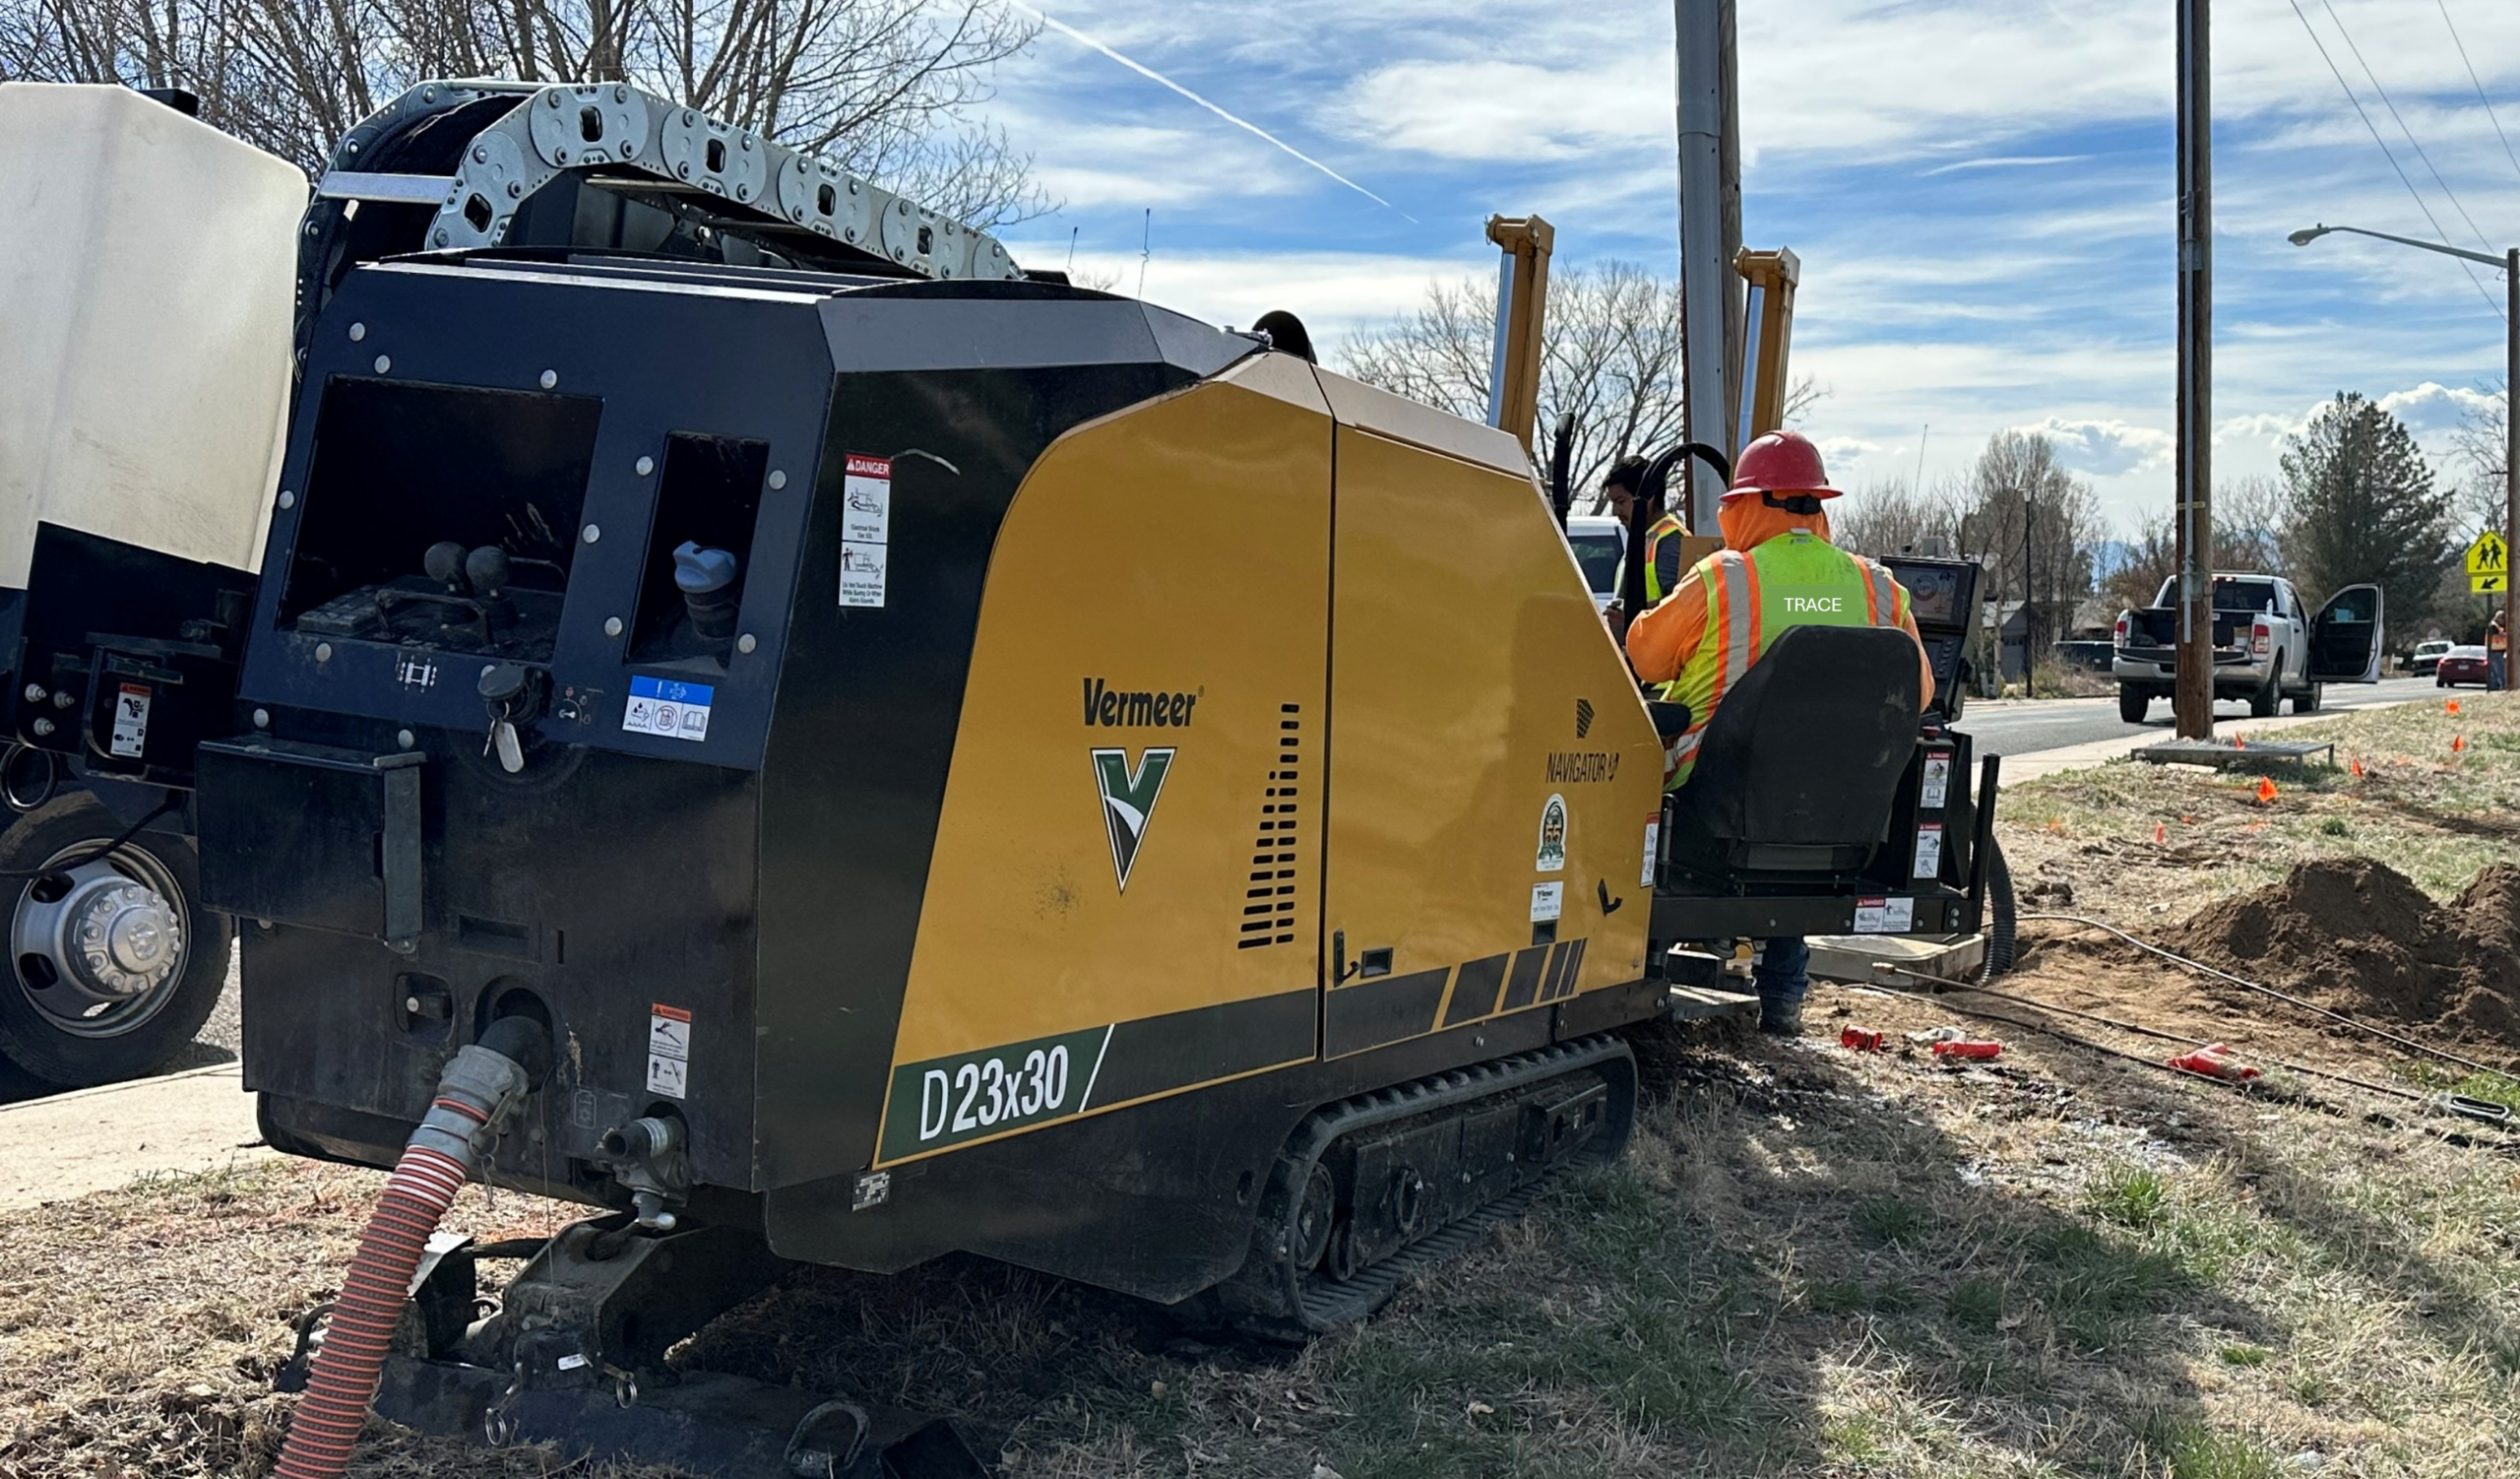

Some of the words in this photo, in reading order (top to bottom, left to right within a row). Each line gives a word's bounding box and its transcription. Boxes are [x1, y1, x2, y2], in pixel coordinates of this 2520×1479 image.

[854, 460, 890, 476] DANGER
[1545, 752, 1607, 784] NAVIGATOR
[1544, 823, 1562, 846] 55
